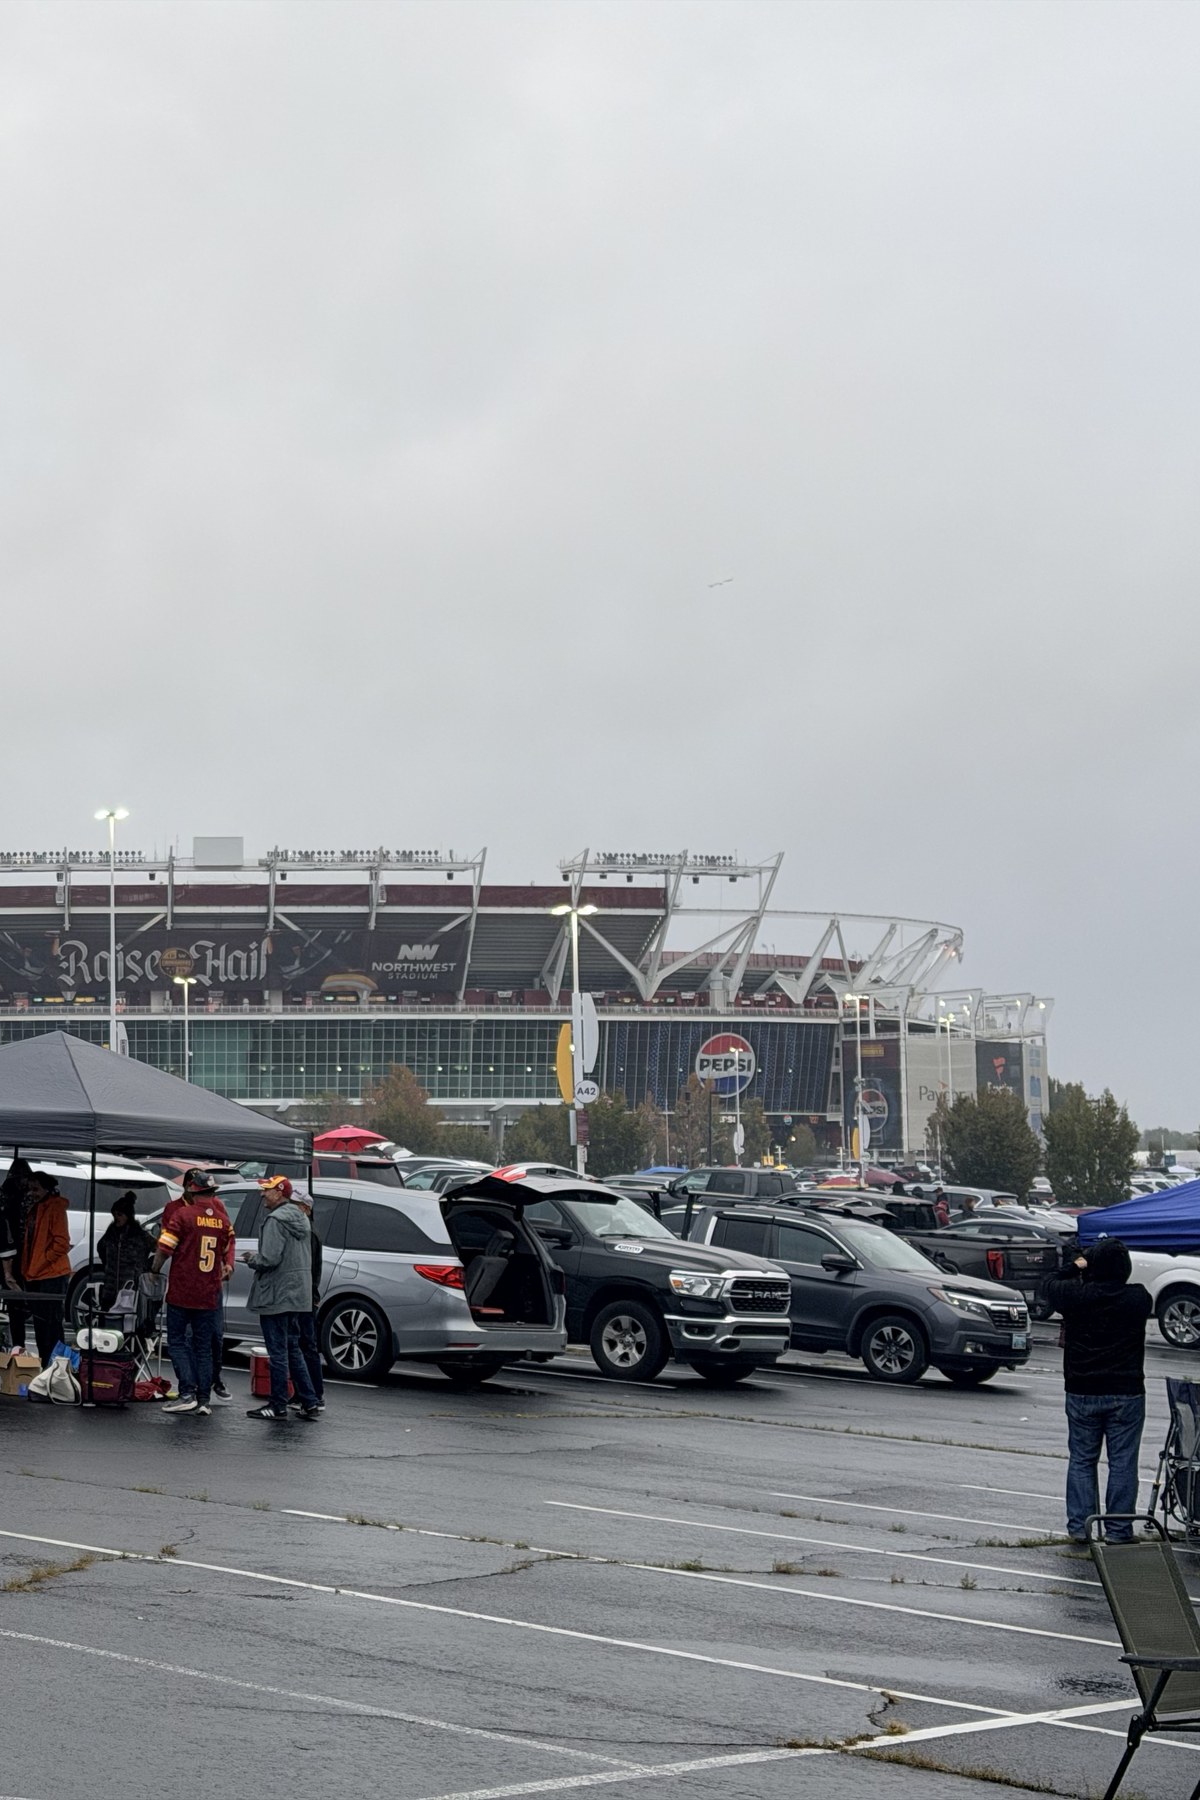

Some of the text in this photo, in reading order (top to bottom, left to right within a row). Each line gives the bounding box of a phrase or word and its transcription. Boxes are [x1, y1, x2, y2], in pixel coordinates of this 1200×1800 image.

[57, 939, 162, 987] Raise
[189, 939, 269, 987] Hail
[371, 962, 457, 972] NORTHWEST
[700, 1059, 752, 1072] PEPSI
[577, 1087, 596, 1096] A42
[196, 1216, 223, 1229] DANIELS
[199, 1235, 217, 1273] 5
[754, 1290, 782, 1299] RAM
